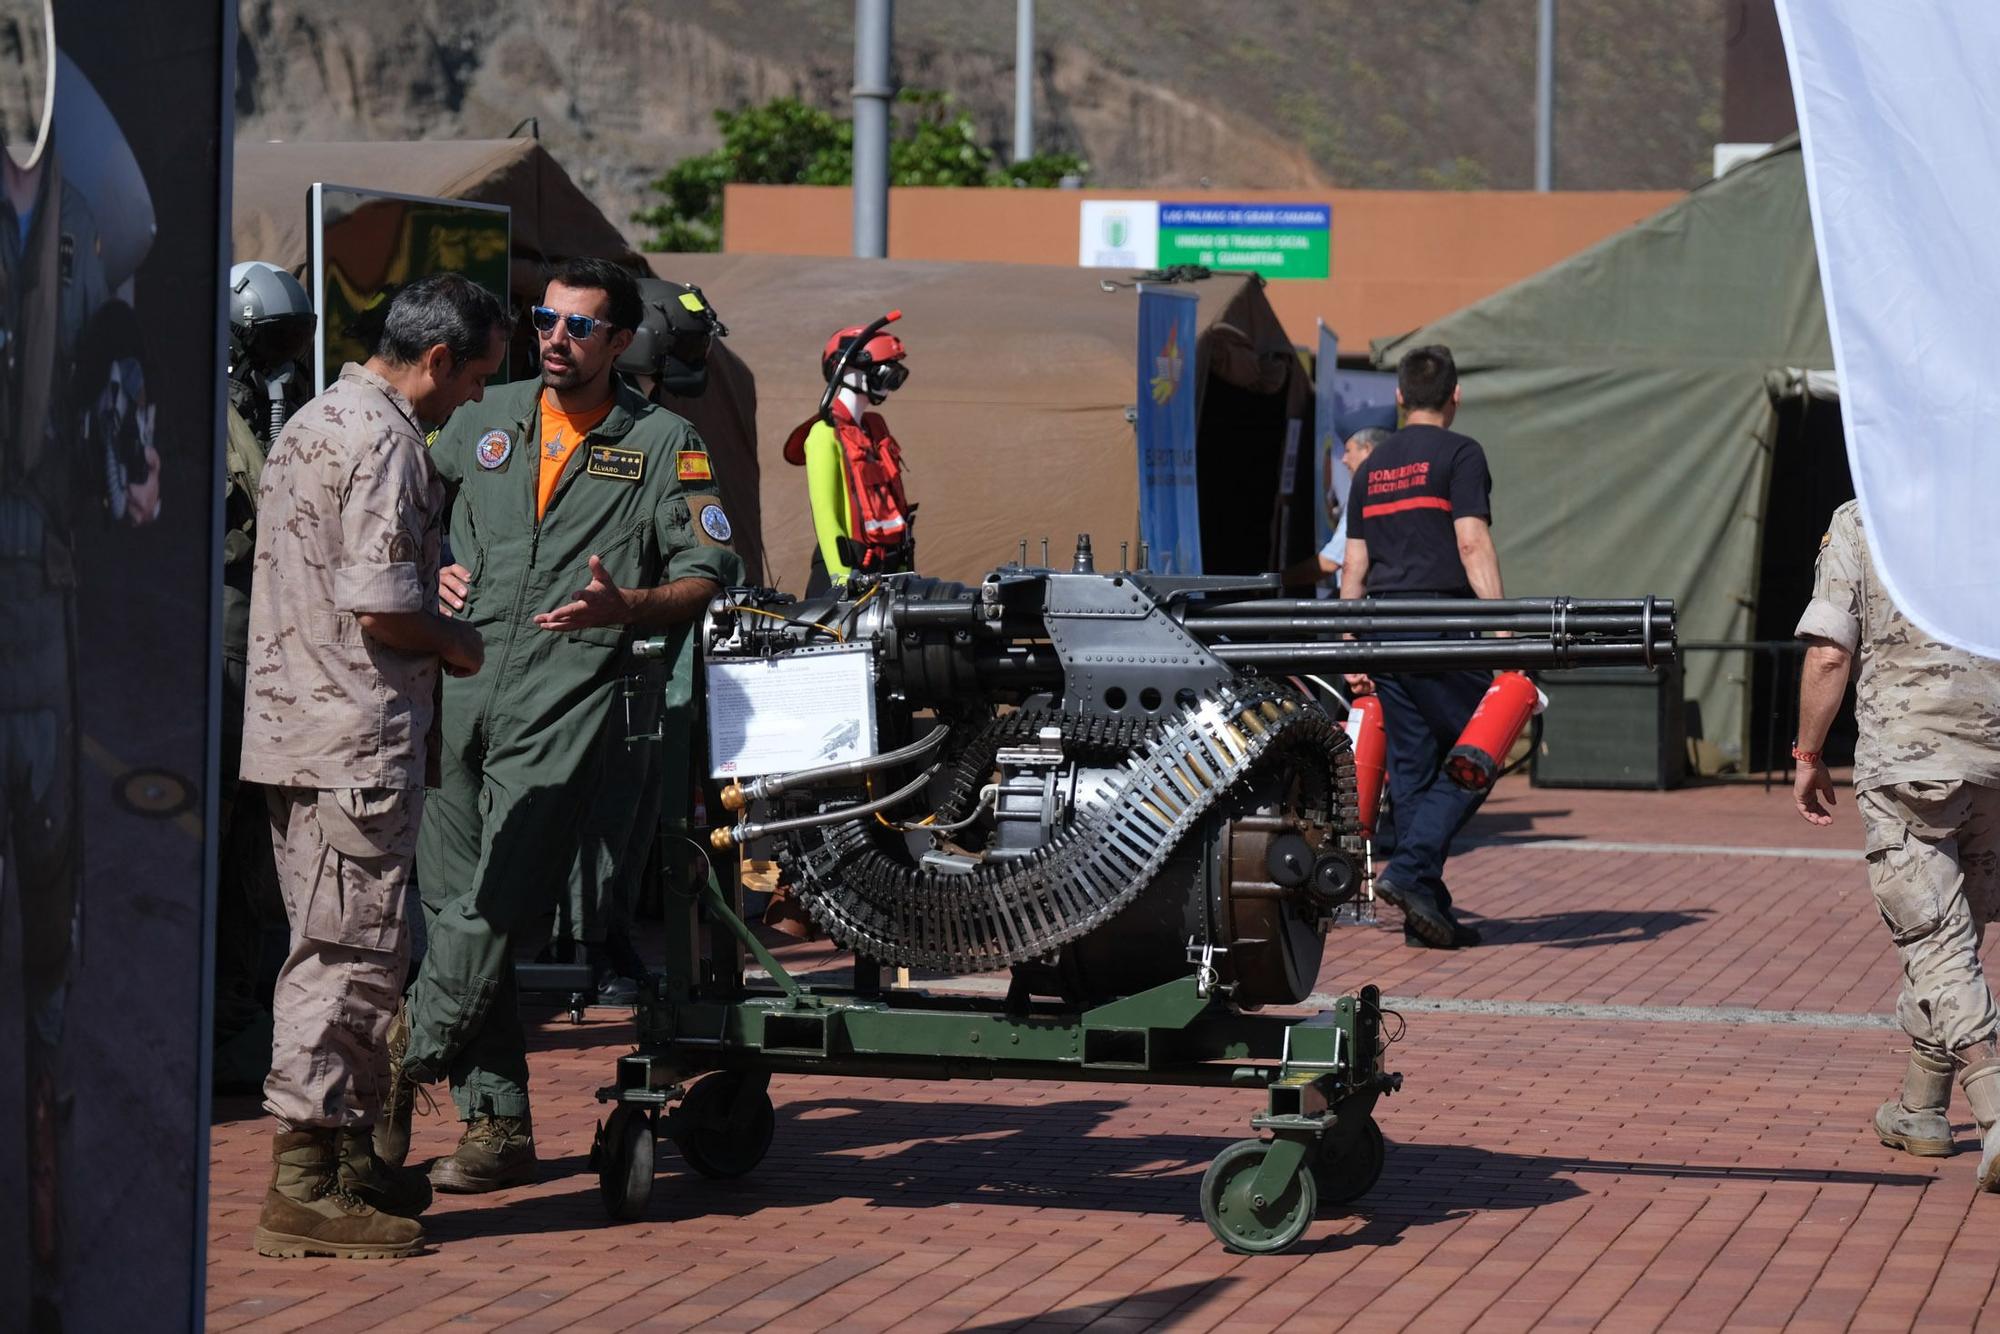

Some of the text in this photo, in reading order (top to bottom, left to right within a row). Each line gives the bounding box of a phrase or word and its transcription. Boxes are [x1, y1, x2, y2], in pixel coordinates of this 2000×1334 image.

[1184, 210, 1227, 224] PALMAS
[1228, 210, 1243, 224] DE
[1244, 210, 1274, 224] GRAN
[1368, 462, 1430, 483] BOMBEROS
